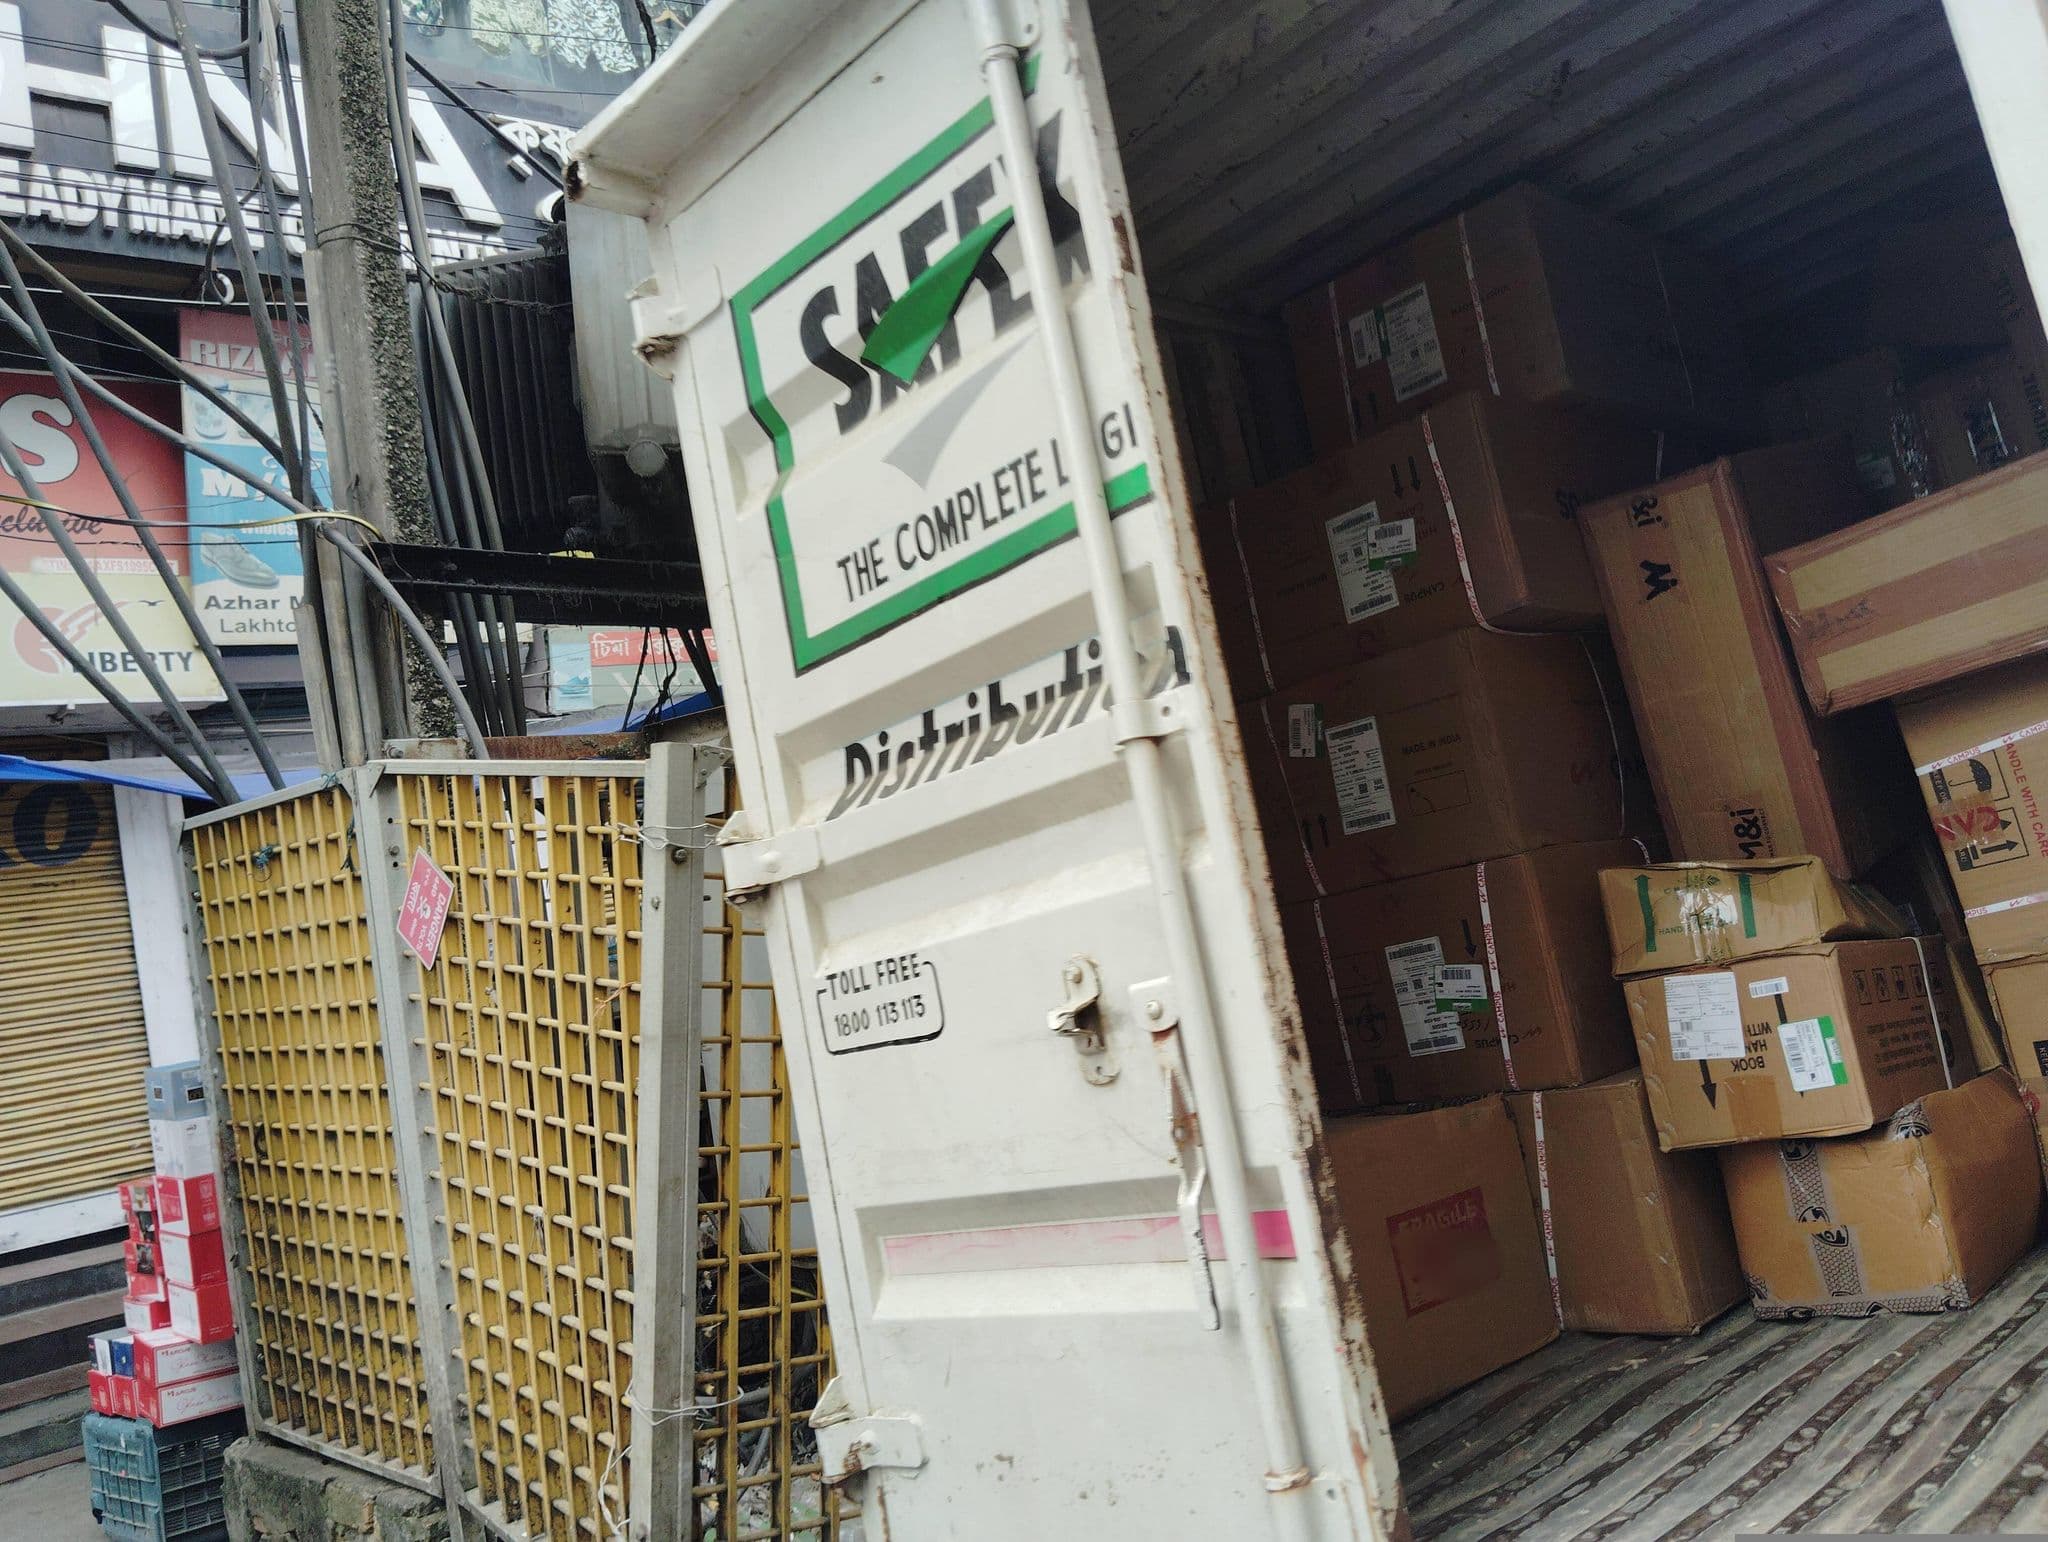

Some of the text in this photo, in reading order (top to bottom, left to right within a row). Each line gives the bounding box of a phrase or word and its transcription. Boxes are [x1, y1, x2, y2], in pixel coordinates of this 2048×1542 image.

[836, 402, 1138, 602] THE COMPLETE LGI
[204, 595, 280, 611] Azhar
[73, 651, 193, 674] IBETY
[1946, 747, 1982, 765] CAMPUS
[2020, 787, 2039, 819] WITH
[426, 893, 447, 952] DANGER
[1482, 923, 1495, 955] CAMPUS
[826, 953, 921, 1000] TOLL FREE
[834, 994, 926, 1037] 1800 113 113
[1493, 991, 1505, 1024] CAMPUS
[1474, 1034, 1520, 1049] CMPUS
[1732, 1055, 1765, 1073] BOOK
[1536, 1140, 1546, 1173] CAMPUS
[1542, 1208, 1553, 1241] CAMPUS
